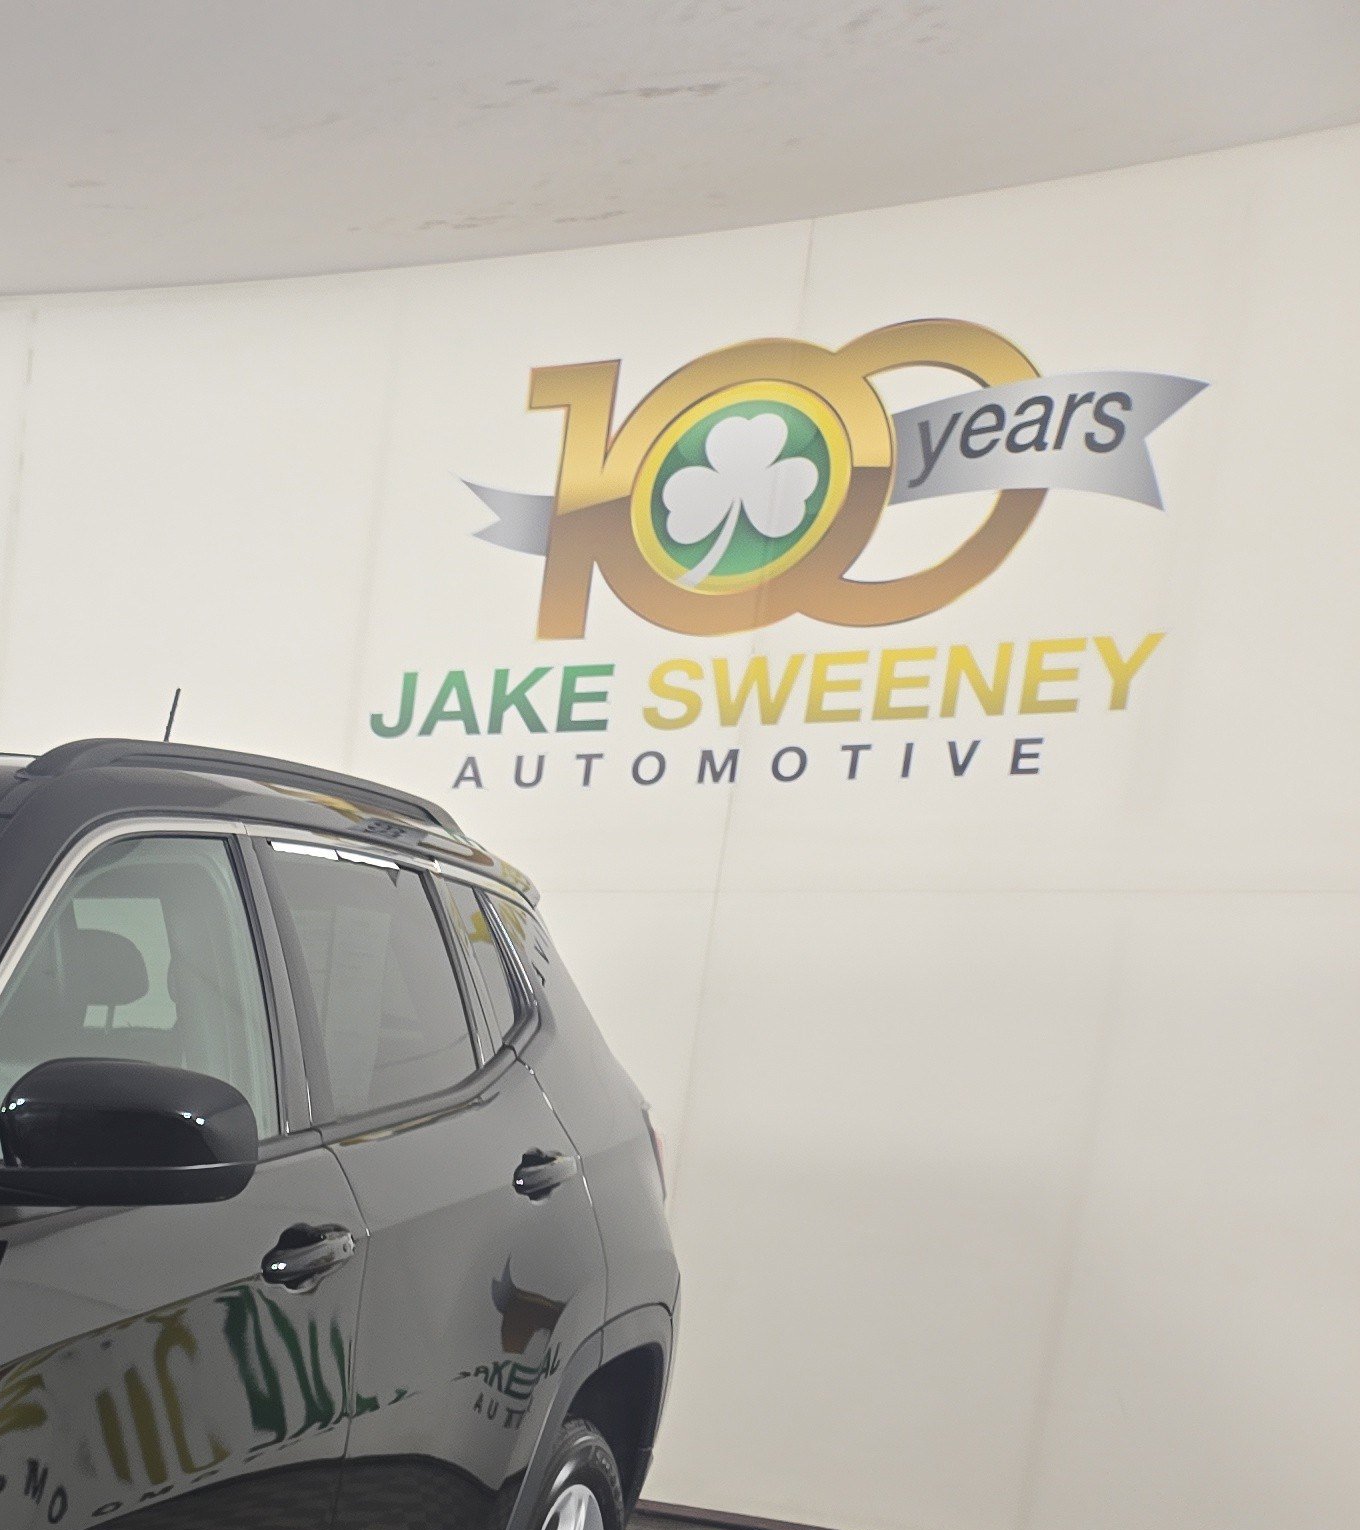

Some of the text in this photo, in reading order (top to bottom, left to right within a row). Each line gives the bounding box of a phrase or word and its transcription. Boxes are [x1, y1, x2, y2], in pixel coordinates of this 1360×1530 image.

[907, 388, 1133, 489] years
[369, 631, 1167, 738] JAKE SWEENEY
[452, 736, 1045, 789] AUTOMOTIVE
